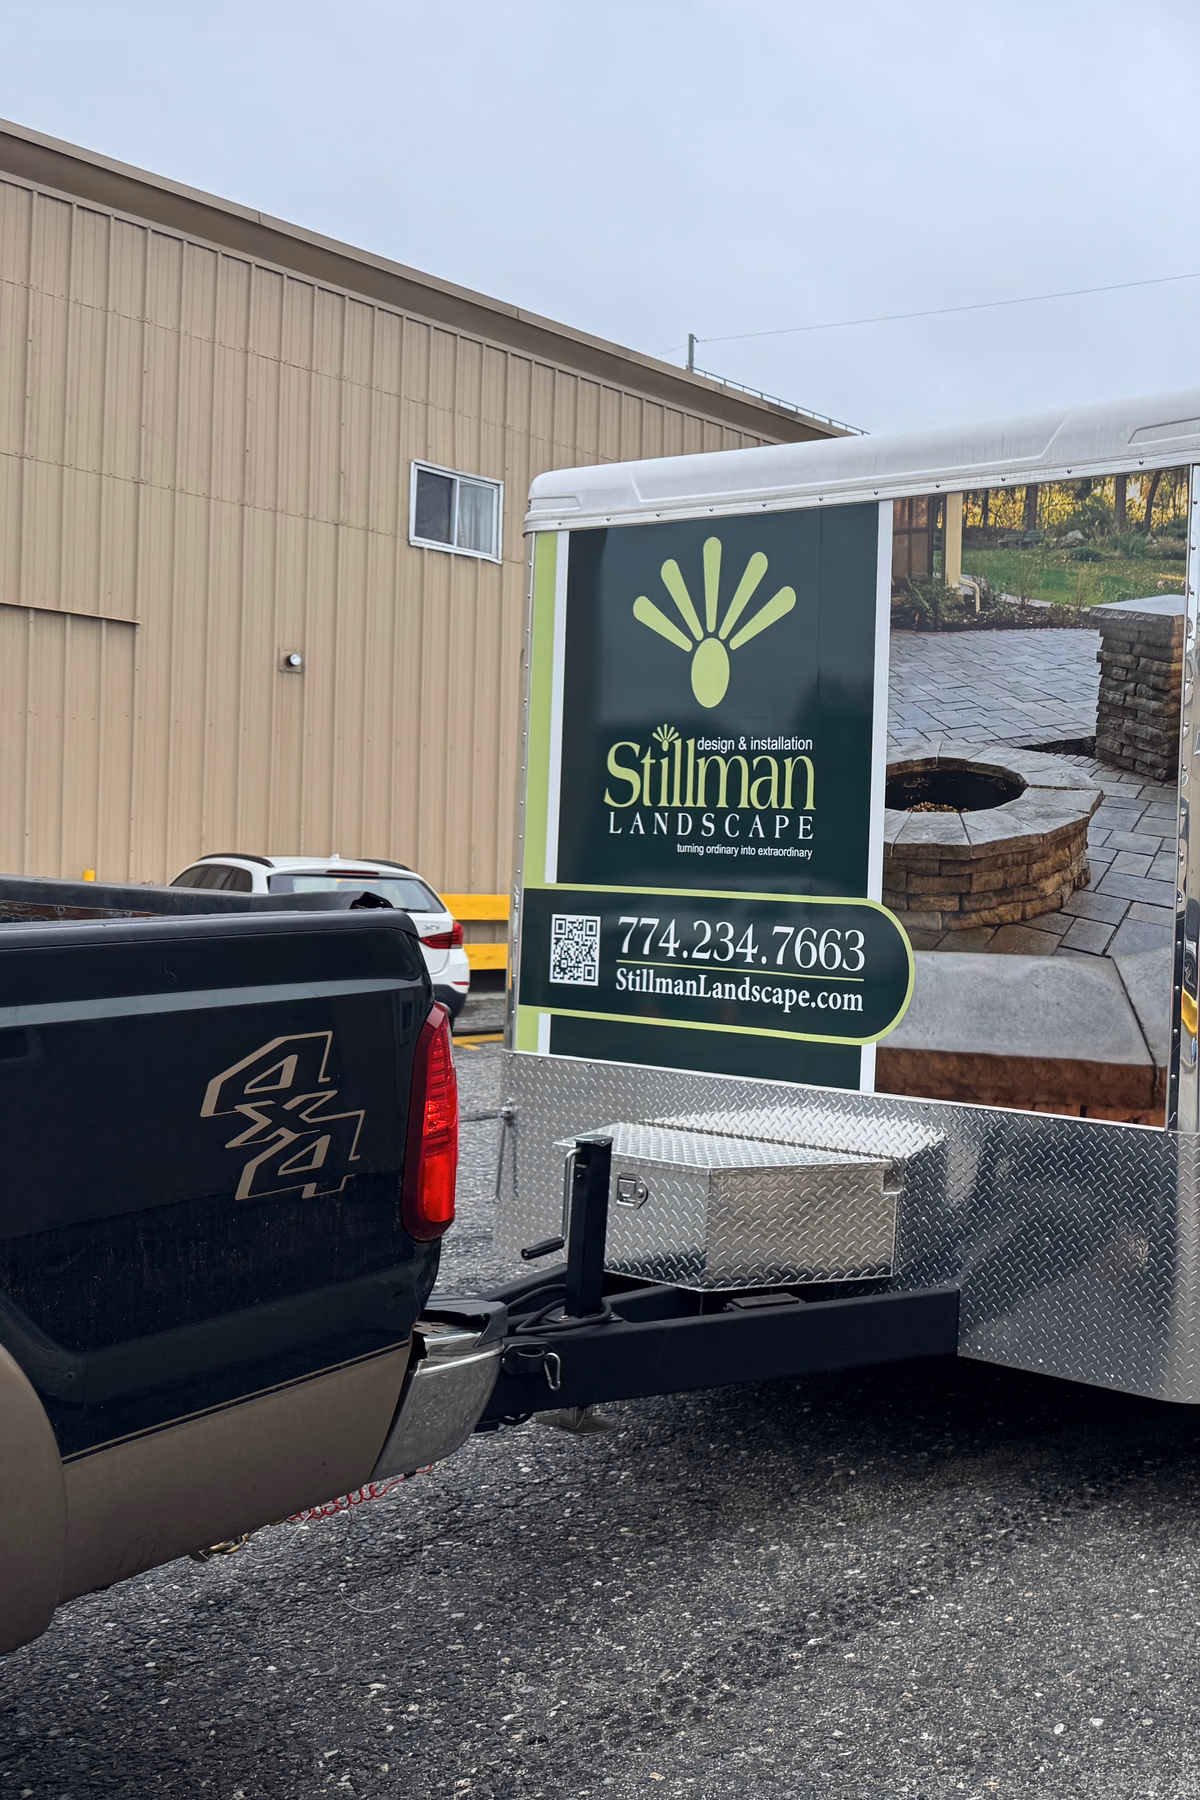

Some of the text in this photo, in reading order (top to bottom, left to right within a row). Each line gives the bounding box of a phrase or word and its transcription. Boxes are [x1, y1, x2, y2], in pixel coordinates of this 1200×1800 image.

[697, 736, 813, 754] design & installation
[603, 737, 817, 811] Stillman
[608, 811, 814, 840] LANDSCAPE
[677, 843, 813, 860] turning ordinary into extraordinary
[617, 916, 866, 972] 774.234.7663
[615, 967, 864, 1013] StillmanLandscape.com
